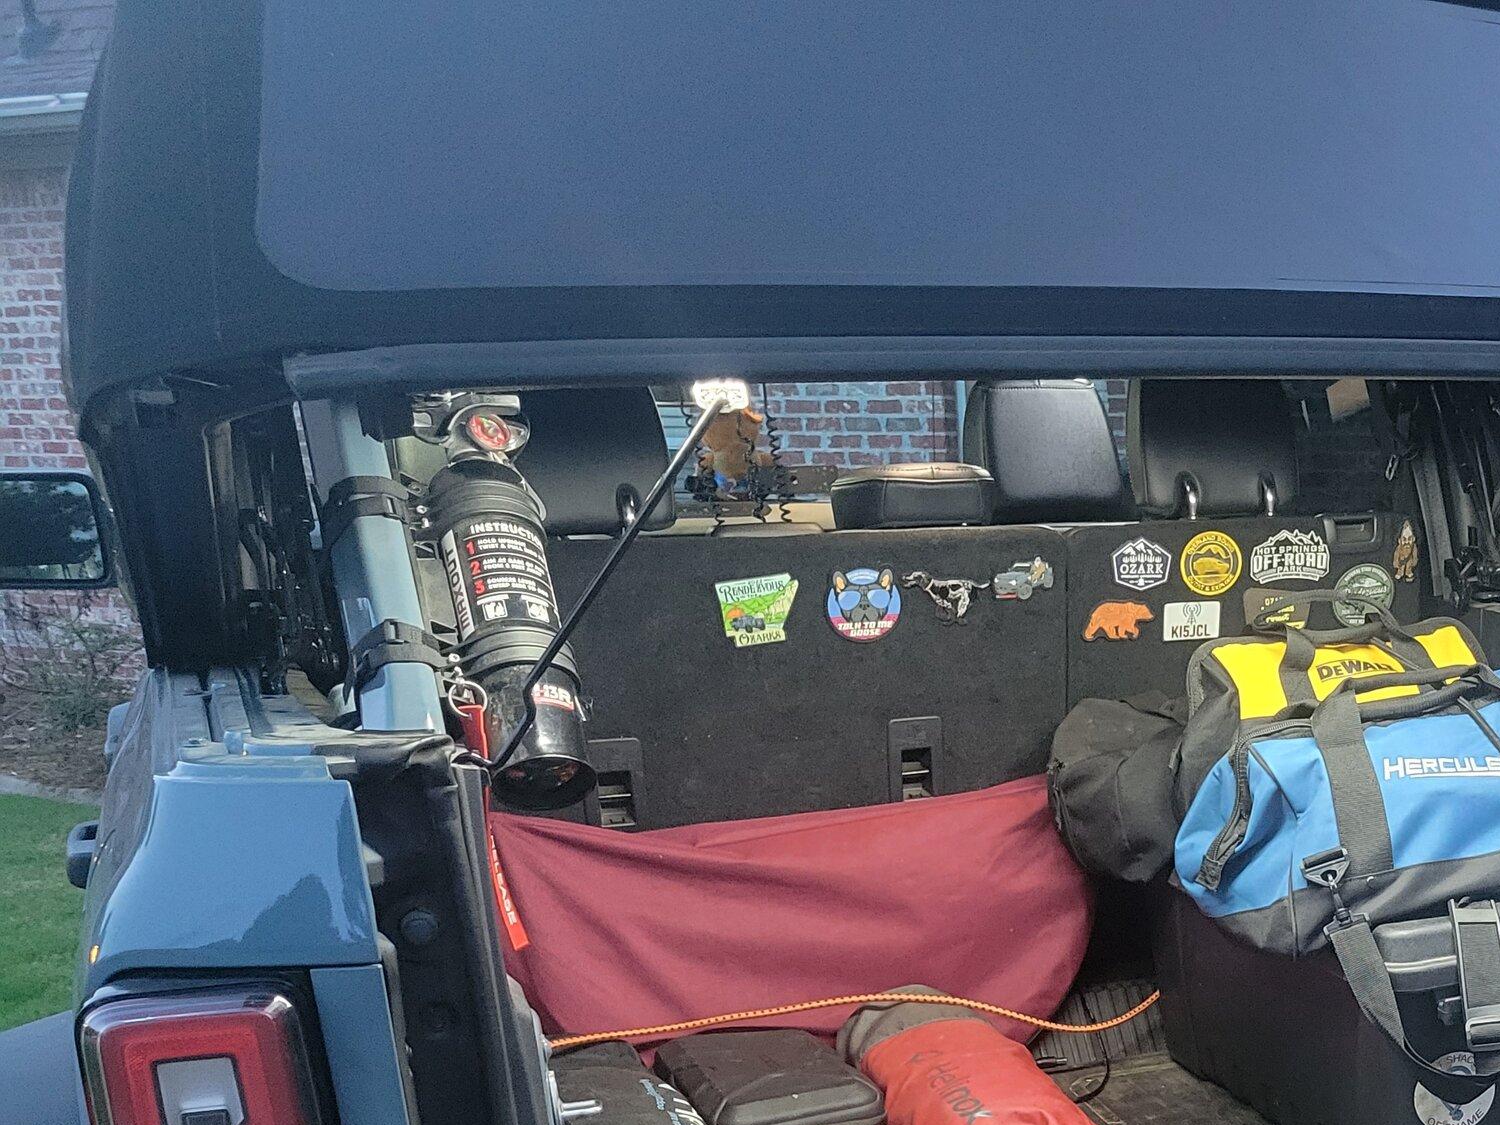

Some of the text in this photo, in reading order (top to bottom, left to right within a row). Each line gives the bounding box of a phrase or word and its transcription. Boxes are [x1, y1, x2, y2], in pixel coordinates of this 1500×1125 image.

[466, 541, 475, 555] 1
[1257, 545, 1325, 555] HOT SPRINGS
[470, 561, 481, 575] 2
[1120, 563, 1163, 574] OZARK
[1277, 566, 1303, 574] PARK
[445, 549, 470, 631] MAXOUT
[474, 579, 485, 594] 3
[719, 580, 784, 602] RENDEZVOUS
[837, 622, 861, 630] TALK
[863, 621, 876, 629] TO
[1171, 624, 1210, 638] KI5JCL
[739, 631, 781, 645] OZARKS
[849, 629, 881, 637] GOOSE
[1446, 1054, 1475, 1064] SHAC
